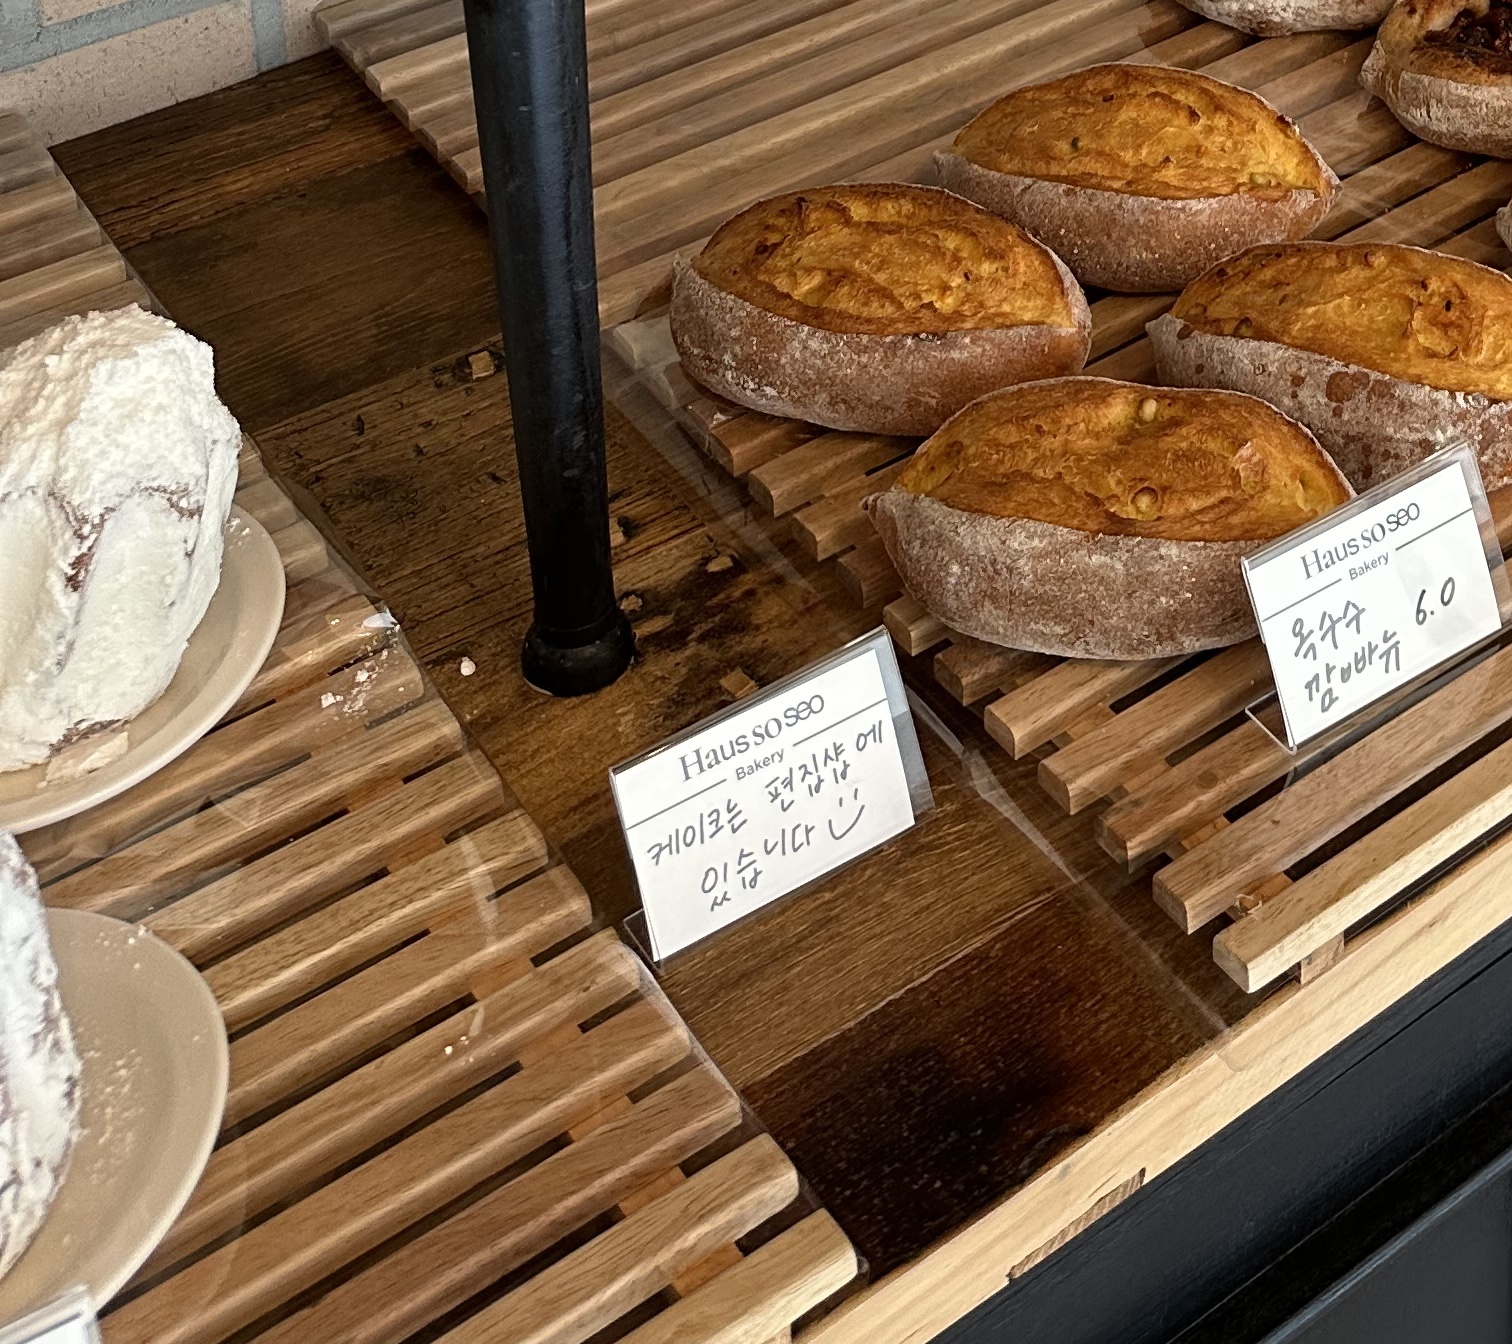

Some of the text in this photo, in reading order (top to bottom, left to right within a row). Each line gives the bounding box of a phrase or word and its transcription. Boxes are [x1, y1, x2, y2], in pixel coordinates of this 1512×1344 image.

[1348, 551, 1390, 582] Bakery
[1291, 576, 1457, 662] 옥수수 6.0
[1304, 628, 1401, 714] 깜빠뉴
[734, 747, 785, 782] Bakery
[646, 797, 749, 867] 케이크는
[700, 823, 816, 913] 있습니다
